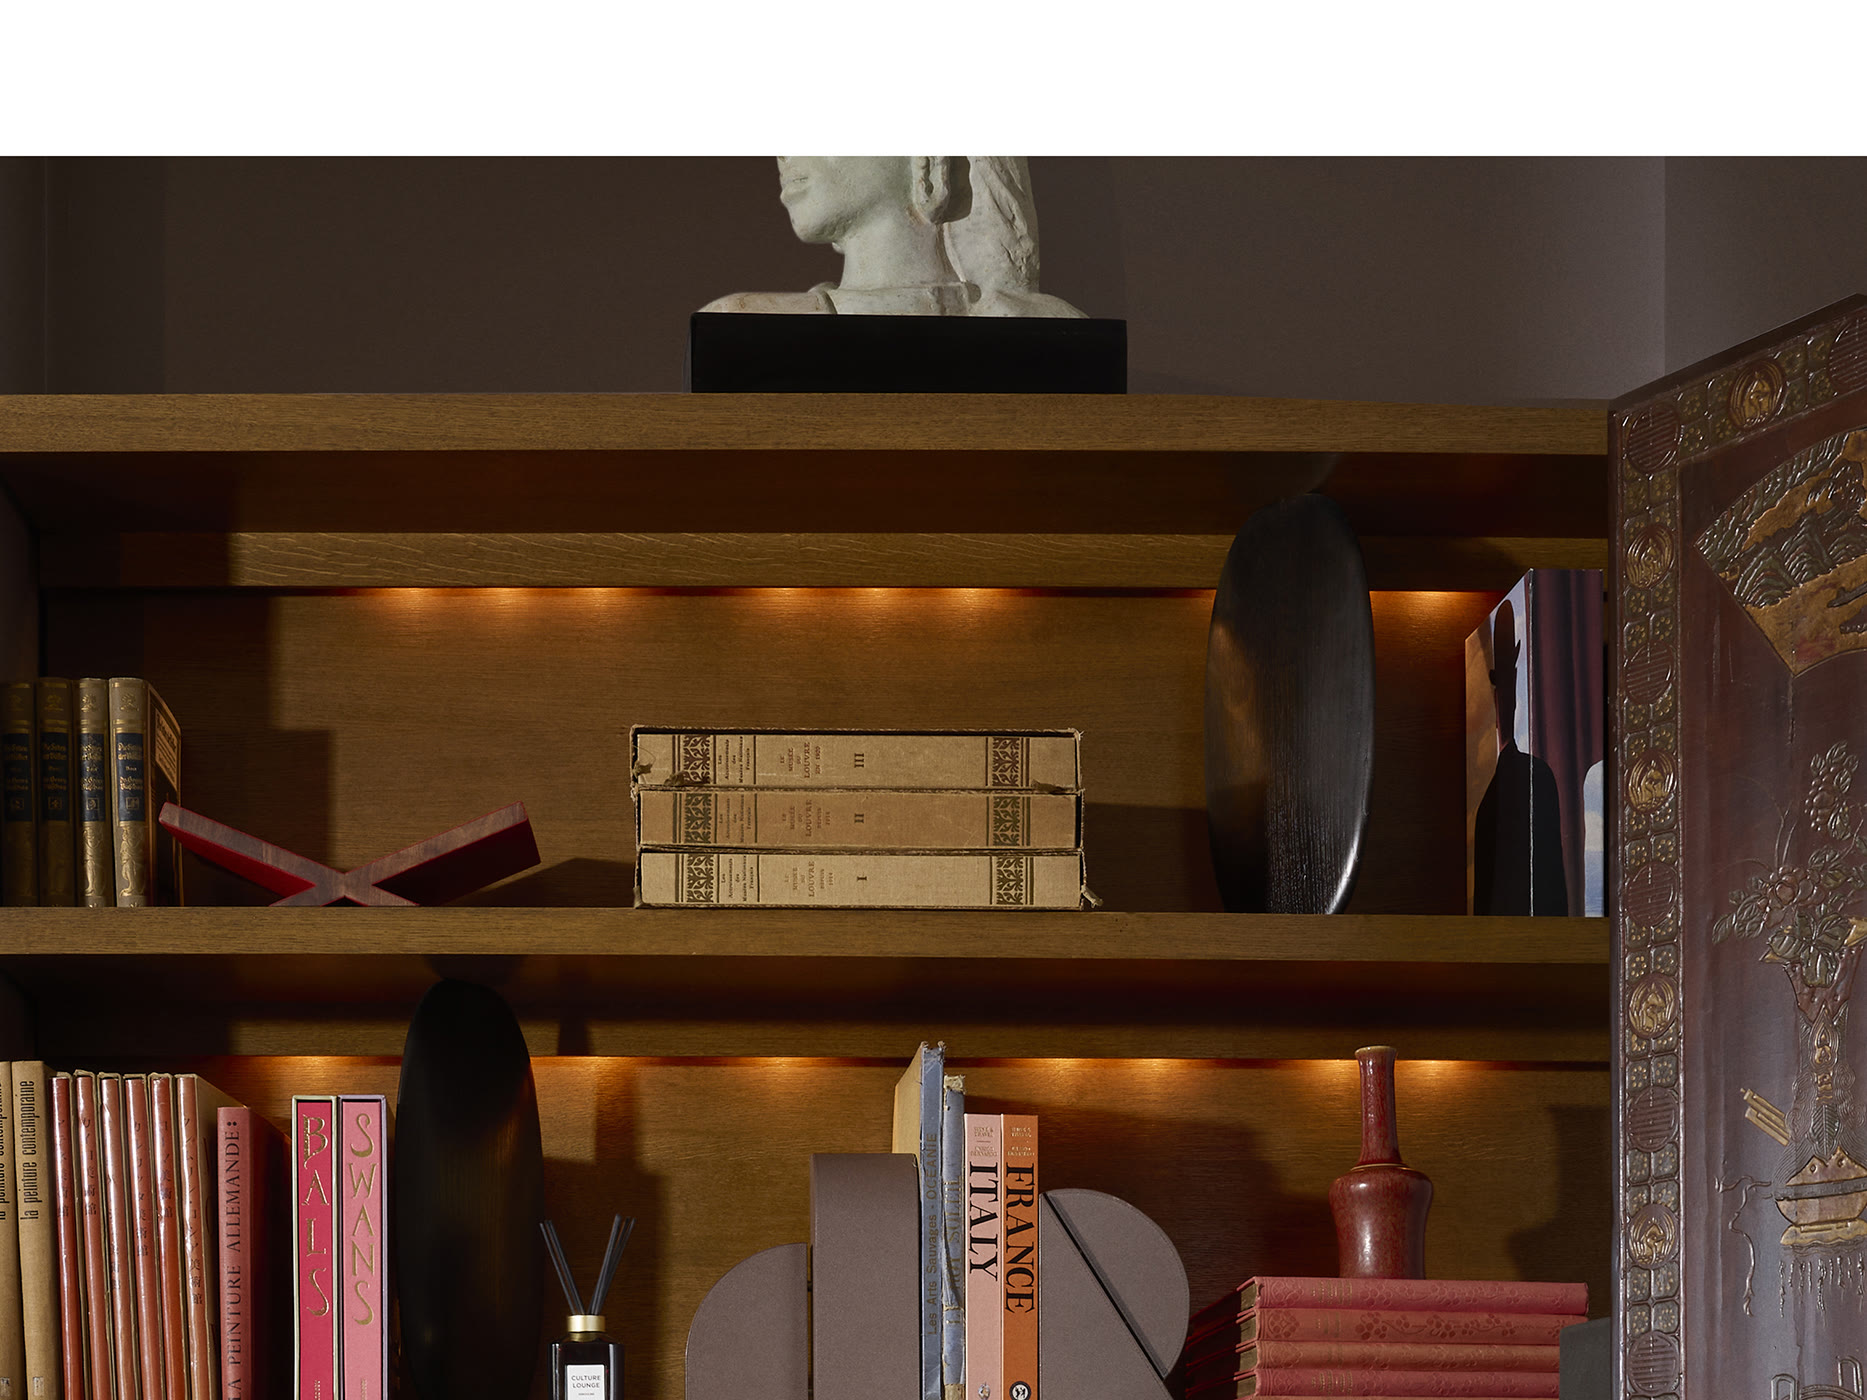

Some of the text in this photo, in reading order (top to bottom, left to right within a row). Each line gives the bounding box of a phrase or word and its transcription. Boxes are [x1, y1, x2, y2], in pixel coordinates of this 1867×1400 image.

[803, 741, 811, 779] LOUVRE
[853, 752, 865, 769] III
[805, 799, 813, 837] LOUVRE
[853, 812, 865, 824] II
[20, 1080, 42, 1220] la peinture contemporaine
[301, 1113, 330, 1317] BALS
[348, 1112, 379, 1326] SWANS
[926, 1214, 939, 1275] Sauvages
[968, 1161, 999, 1282] ITALY
[1004, 1161, 1036, 1315] FRANCE
[226, 1264, 241, 1365] PEINTURE
[926, 1280, 938, 1307] Arts
[927, 1312, 938, 1336] Les
